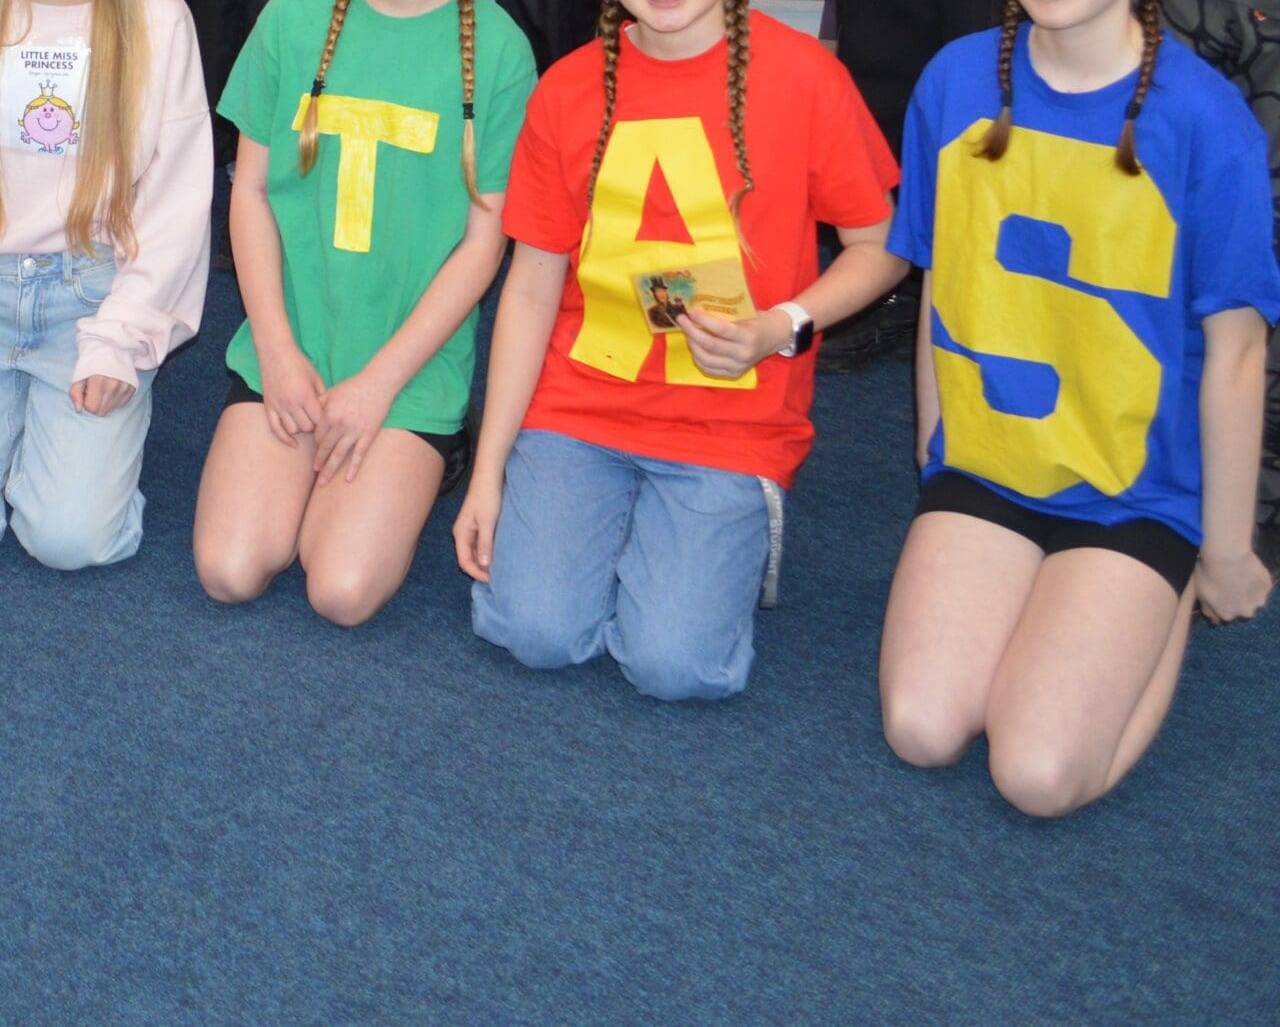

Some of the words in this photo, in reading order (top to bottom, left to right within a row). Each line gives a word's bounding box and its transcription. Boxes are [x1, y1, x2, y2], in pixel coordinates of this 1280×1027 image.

[21, 51, 49, 60] LITTLE
[53, 52, 78, 61] MISS
[24, 60, 74, 70] PRINCESS
[291, 93, 440, 253] T
[569, 116, 760, 391] A
[931, 119, 1178, 499] S
